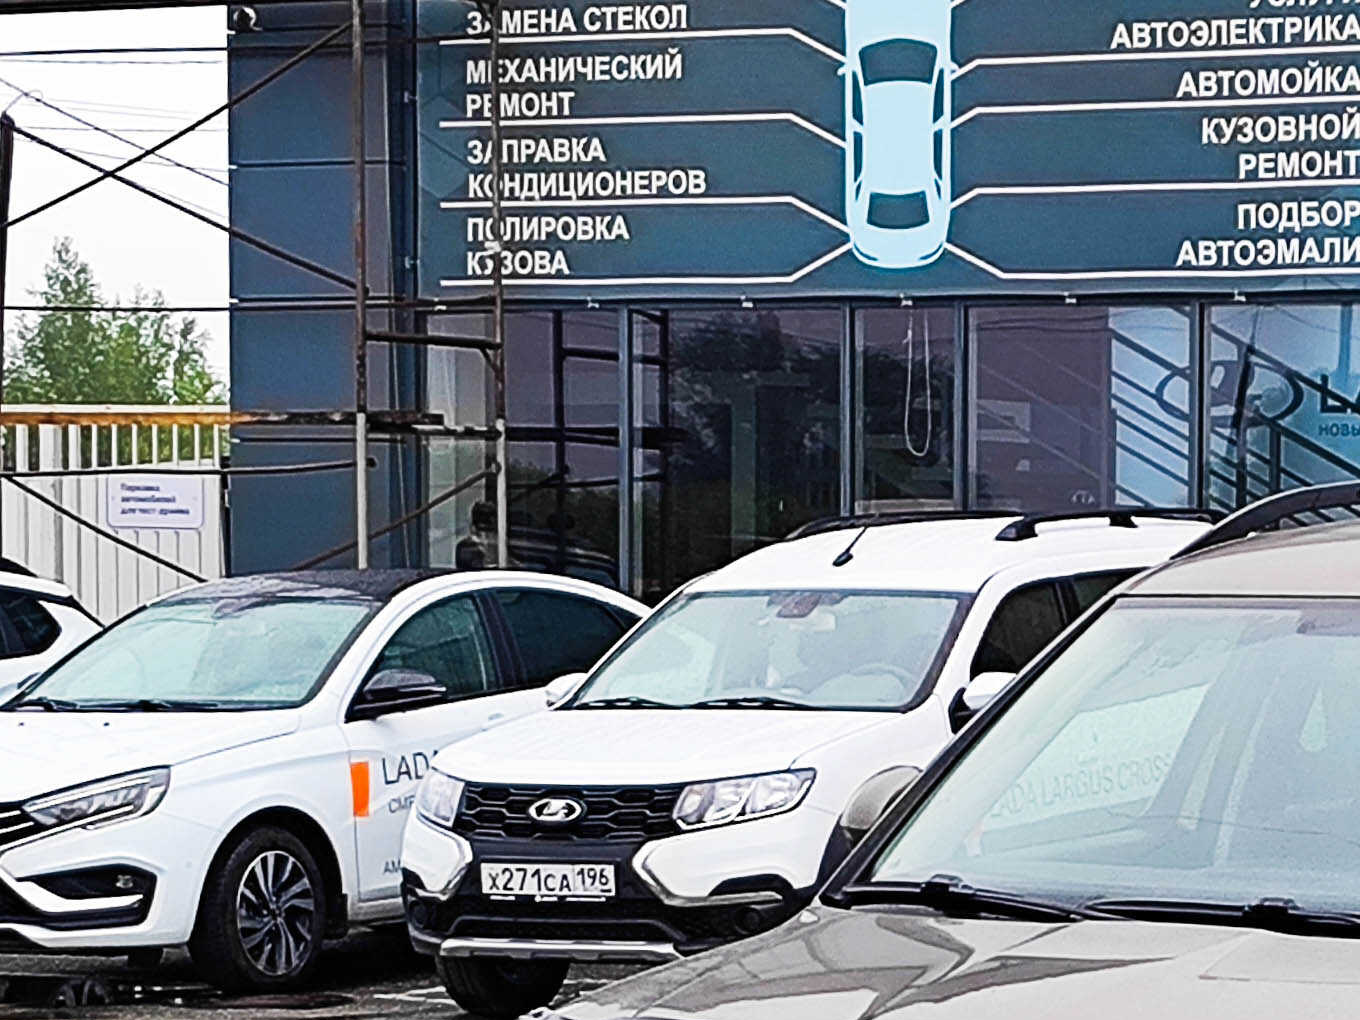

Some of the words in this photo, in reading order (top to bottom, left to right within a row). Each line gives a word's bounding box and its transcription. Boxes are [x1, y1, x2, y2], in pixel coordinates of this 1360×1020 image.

[466, 8, 577, 35] ЗМЕНА
[583, 4, 688, 32] СТЕКОЛ
[466, 48, 682, 84] МЕХАНИЧЕСКИЙ
[466, 91, 575, 118] РЕМОНТ
[468, 169, 706, 200] КОНДИЦИОНЕРОВ
[466, 215, 630, 242] ПОЛИРОВКА
[382, 750, 438, 785] LAD
[990, 782, 1038, 817] ADA
[576, 867, 609, 887] 196
